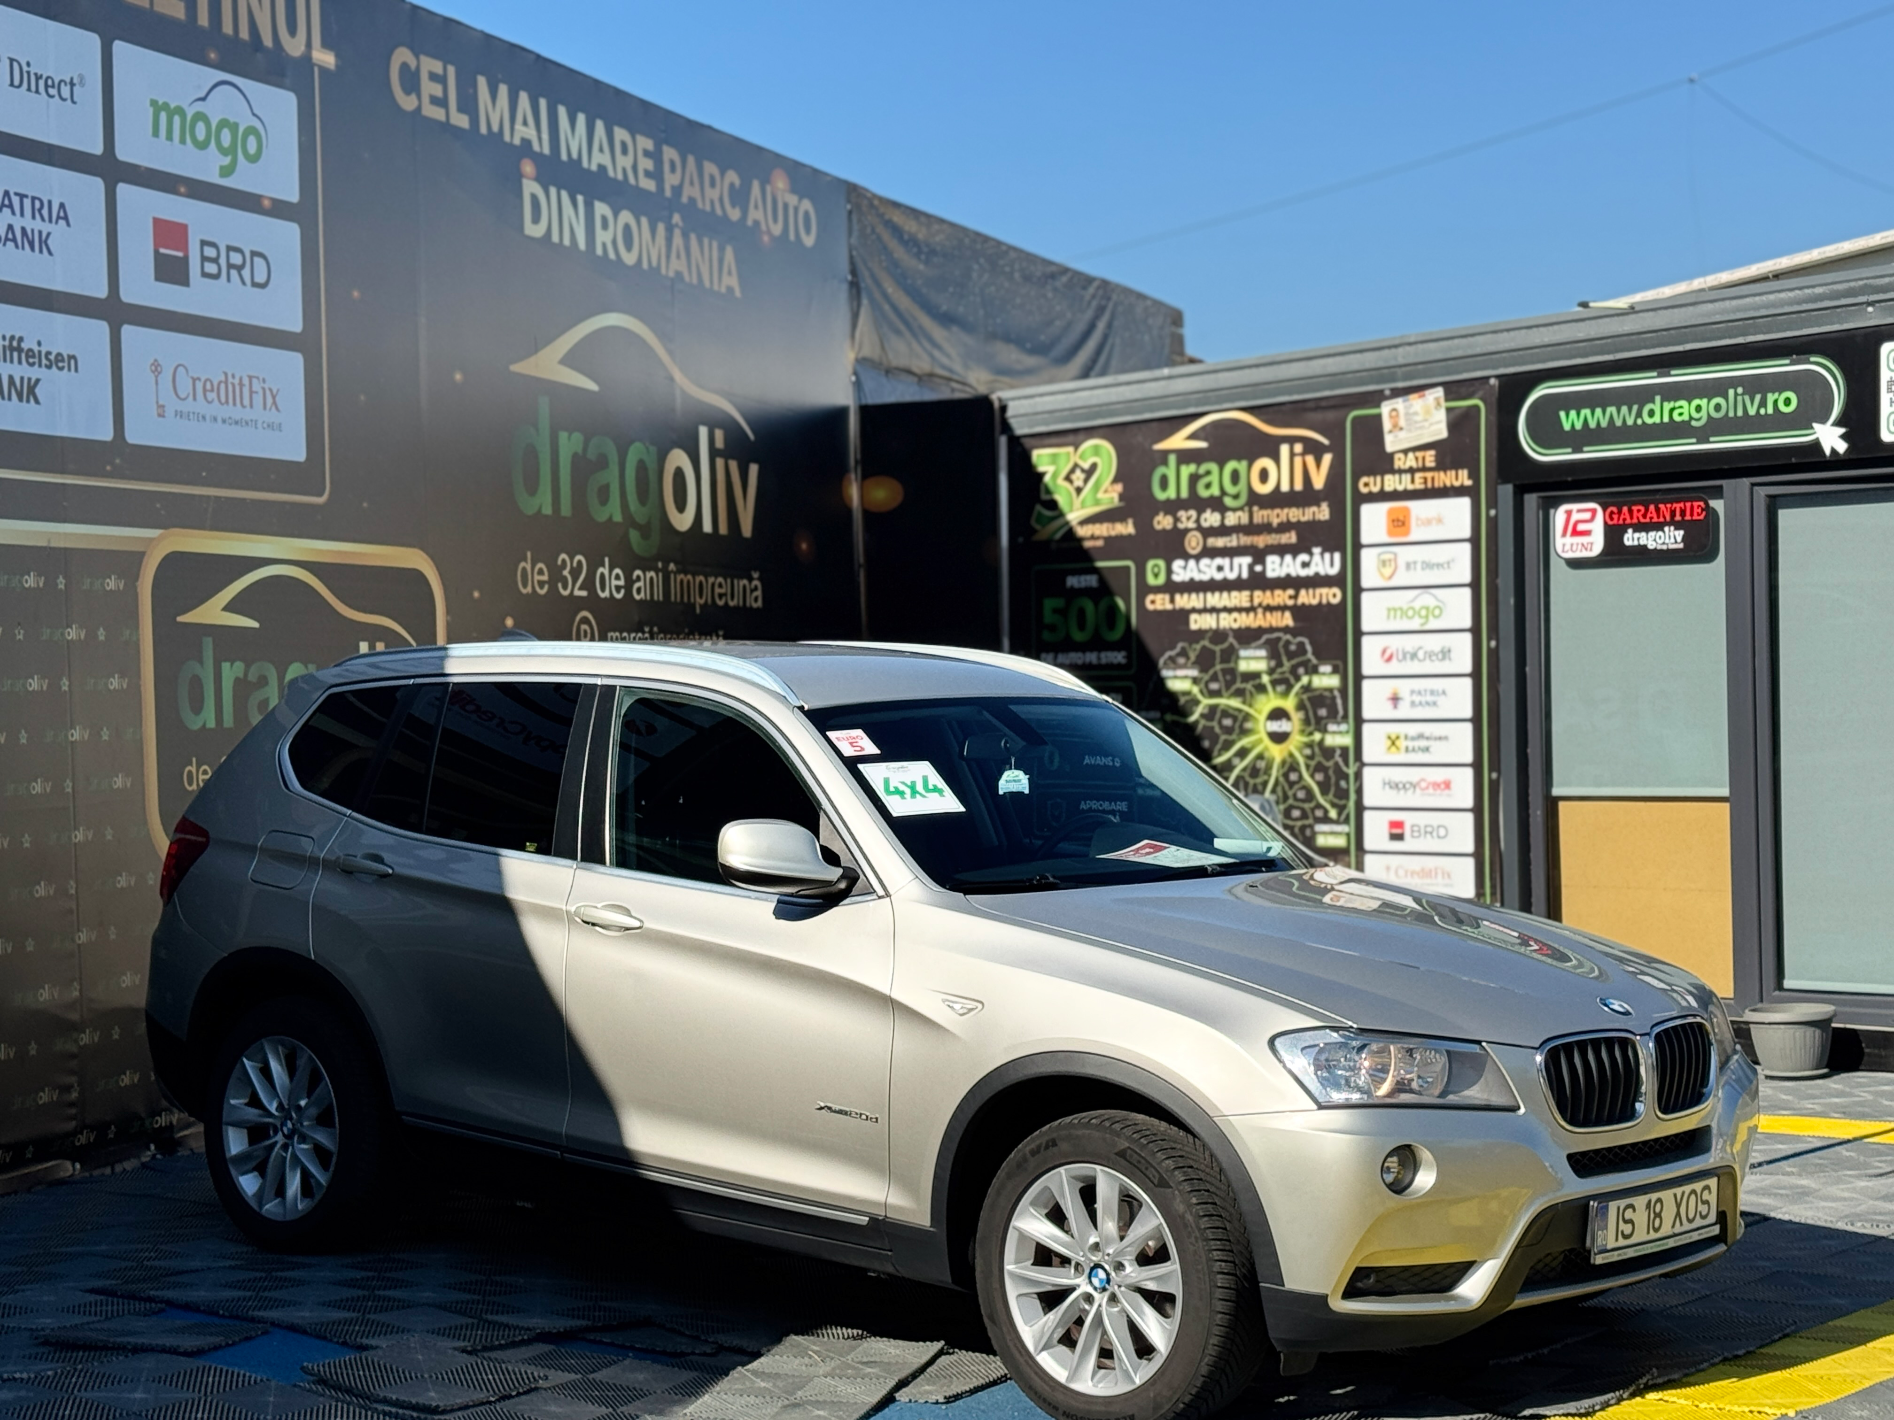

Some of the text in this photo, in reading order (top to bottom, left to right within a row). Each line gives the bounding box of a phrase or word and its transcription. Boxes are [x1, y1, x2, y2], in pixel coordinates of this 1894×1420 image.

[149, 97, 263, 179] mogo
[389, 45, 818, 248] CEL MAI MARE PARC AUTO
[0, 189, 71, 228] ATRIA
[0, 223, 54, 257] ANK
[521, 177, 741, 298] DIN ROMÂNIA
[199, 238, 271, 290] BRD
[0, 334, 79, 374] iffeisen
[171, 363, 281, 413] CreditFix
[174, 409, 283, 432] PRIETEN IN MOMENTE CHEIE
[1558, 386, 1799, 432] www.dragoliv.ro
[1393, 450, 1437, 469] RATE
[511, 396, 759, 557] dragoliv
[1151, 442, 1333, 508] dragoliv
[1358, 469, 1473, 494] CU BULETINUL
[1152, 502, 1330, 530] de 32 de ani împreună
[1391, 512, 1445, 528] tbi bank
[1561, 507, 1598, 539] 12
[1604, 501, 1706, 525] GARANTIE
[1561, 541, 1594, 554] LUNI
[1623, 526, 1685, 549] dragoliv
[1171, 555, 1253, 583] SASCUT
[1265, 547, 1341, 579] BACĂU
[1405, 561, 1418, 572] BT
[517, 551, 763, 615] de 32 de ani împreună
[1065, 574, 1099, 588] PESTE
[1145, 587, 1342, 611] CEL MAI MARE PARC AUTO
[1041, 596, 1127, 642] 500
[1189, 609, 1295, 630] DIN ROMÂNIA
[1385, 604, 1443, 627] mogo
[1055, 652, 1084, 665] AUTO
[1085, 652, 1098, 664] PE
[1098, 651, 1127, 664] STOC
[1396, 646, 1452, 663] UniCredit
[1410, 688, 1447, 698] PATRIA
[1410, 700, 1439, 708] BANK
[848, 741, 865, 752] 5
[1404, 745, 1432, 754] BANK
[1083, 755, 1112, 767] AVANS
[1382, 778, 1452, 795] HappyCredit
[1079, 800, 1129, 812] APROBARE
[1410, 824, 1449, 839] BRD
[1394, 864, 1453, 880] CreditFix
[1614, 1184, 1713, 1242] IS 18 XOS
